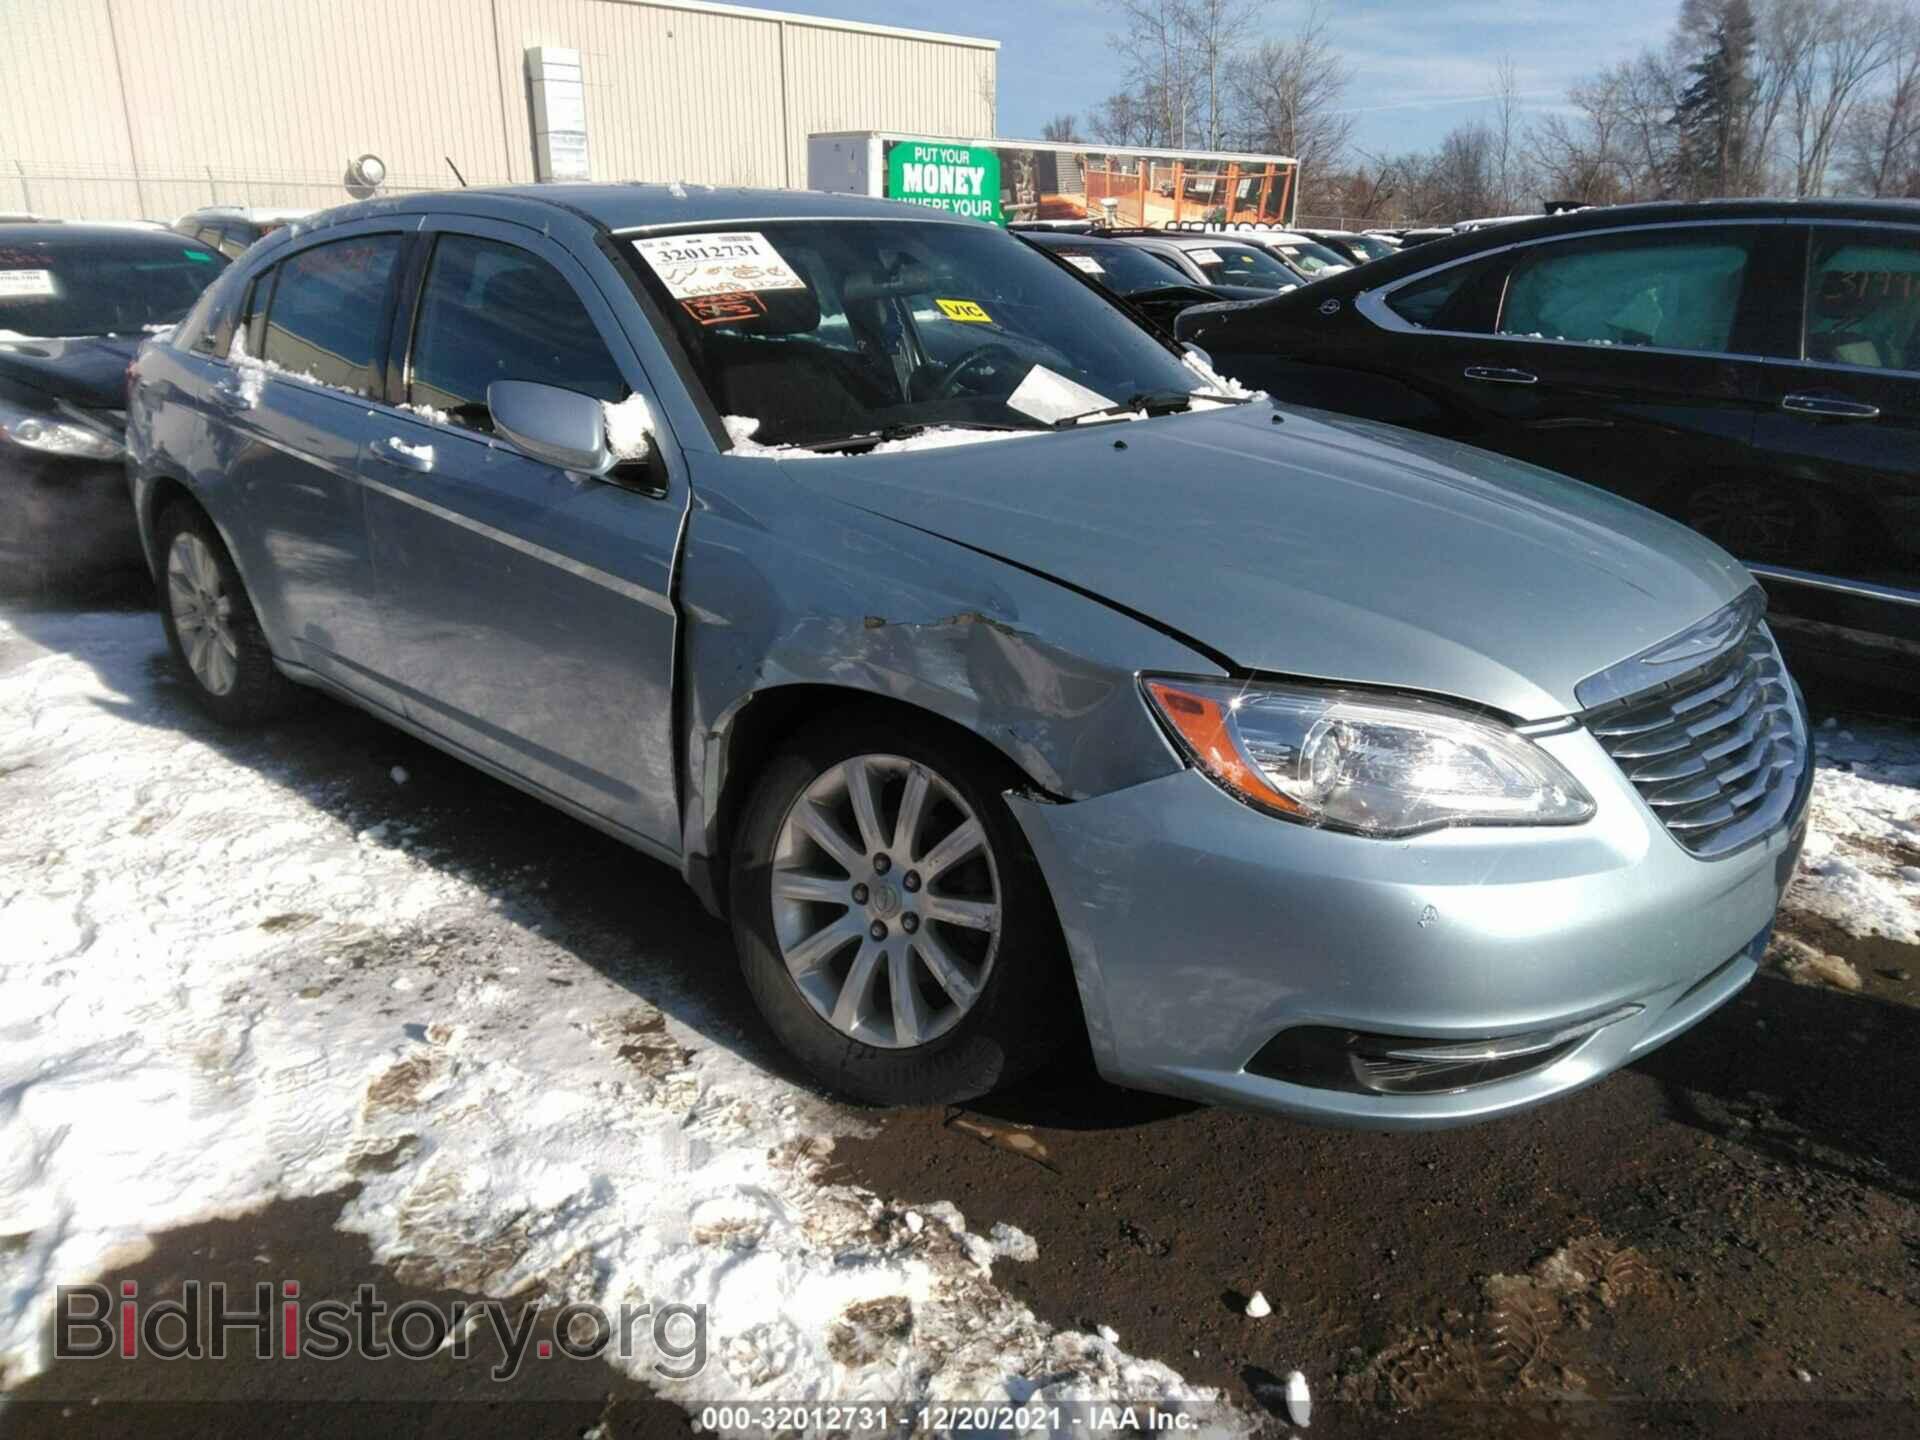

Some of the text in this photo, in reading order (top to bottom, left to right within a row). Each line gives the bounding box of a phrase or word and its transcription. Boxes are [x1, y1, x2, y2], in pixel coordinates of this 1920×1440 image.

[914, 146, 970, 165] PUT YOUR
[902, 162, 985, 195] MONEY
[951, 199, 992, 216] YOUR
[657, 244, 760, 263] 32012731
[945, 303, 984, 318] VIC
